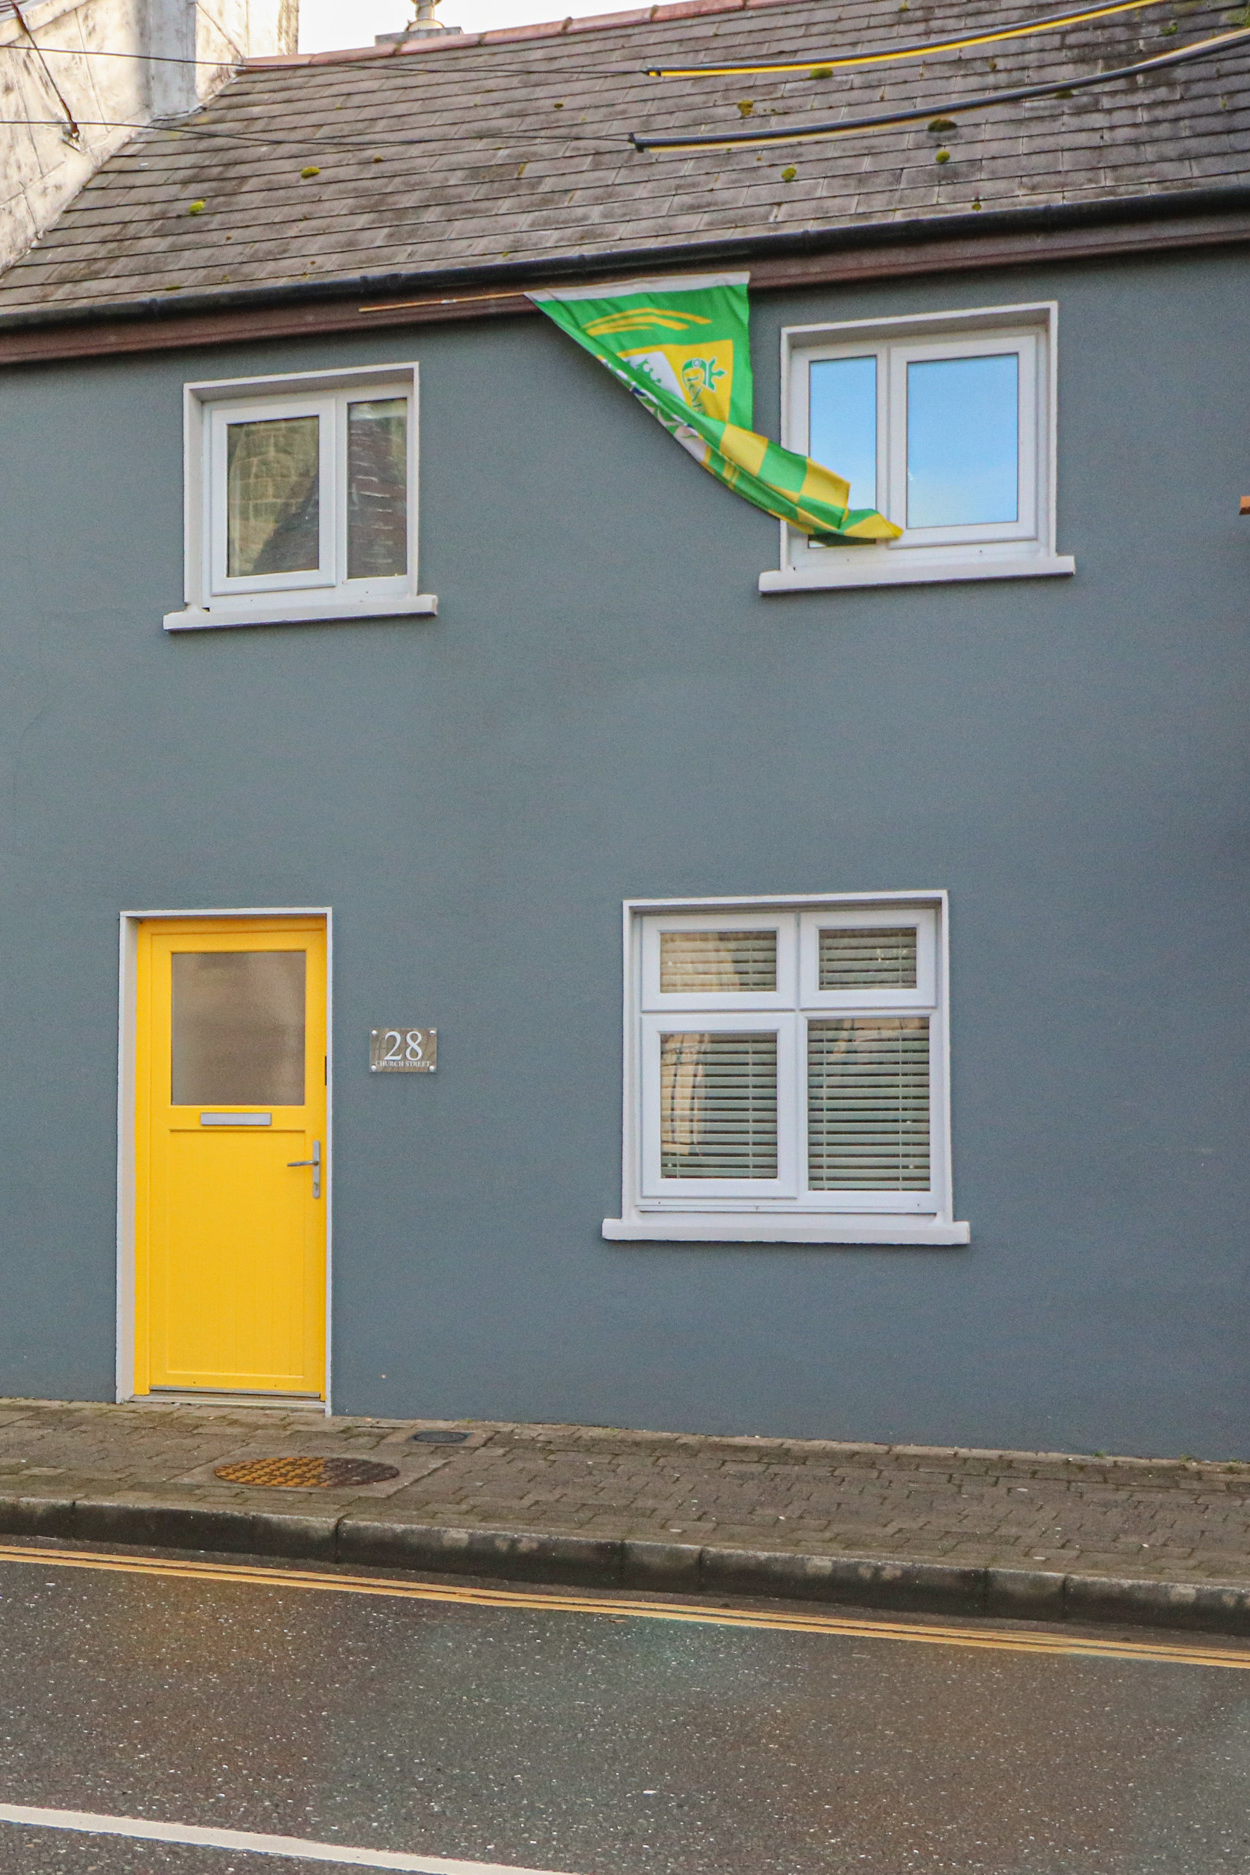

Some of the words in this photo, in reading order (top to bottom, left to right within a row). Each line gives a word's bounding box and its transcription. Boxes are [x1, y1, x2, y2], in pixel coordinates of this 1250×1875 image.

[383, 1030, 423, 1062] 28
[375, 1060, 404, 1068] CHURCH
[405, 1060, 431, 1068] STREET
